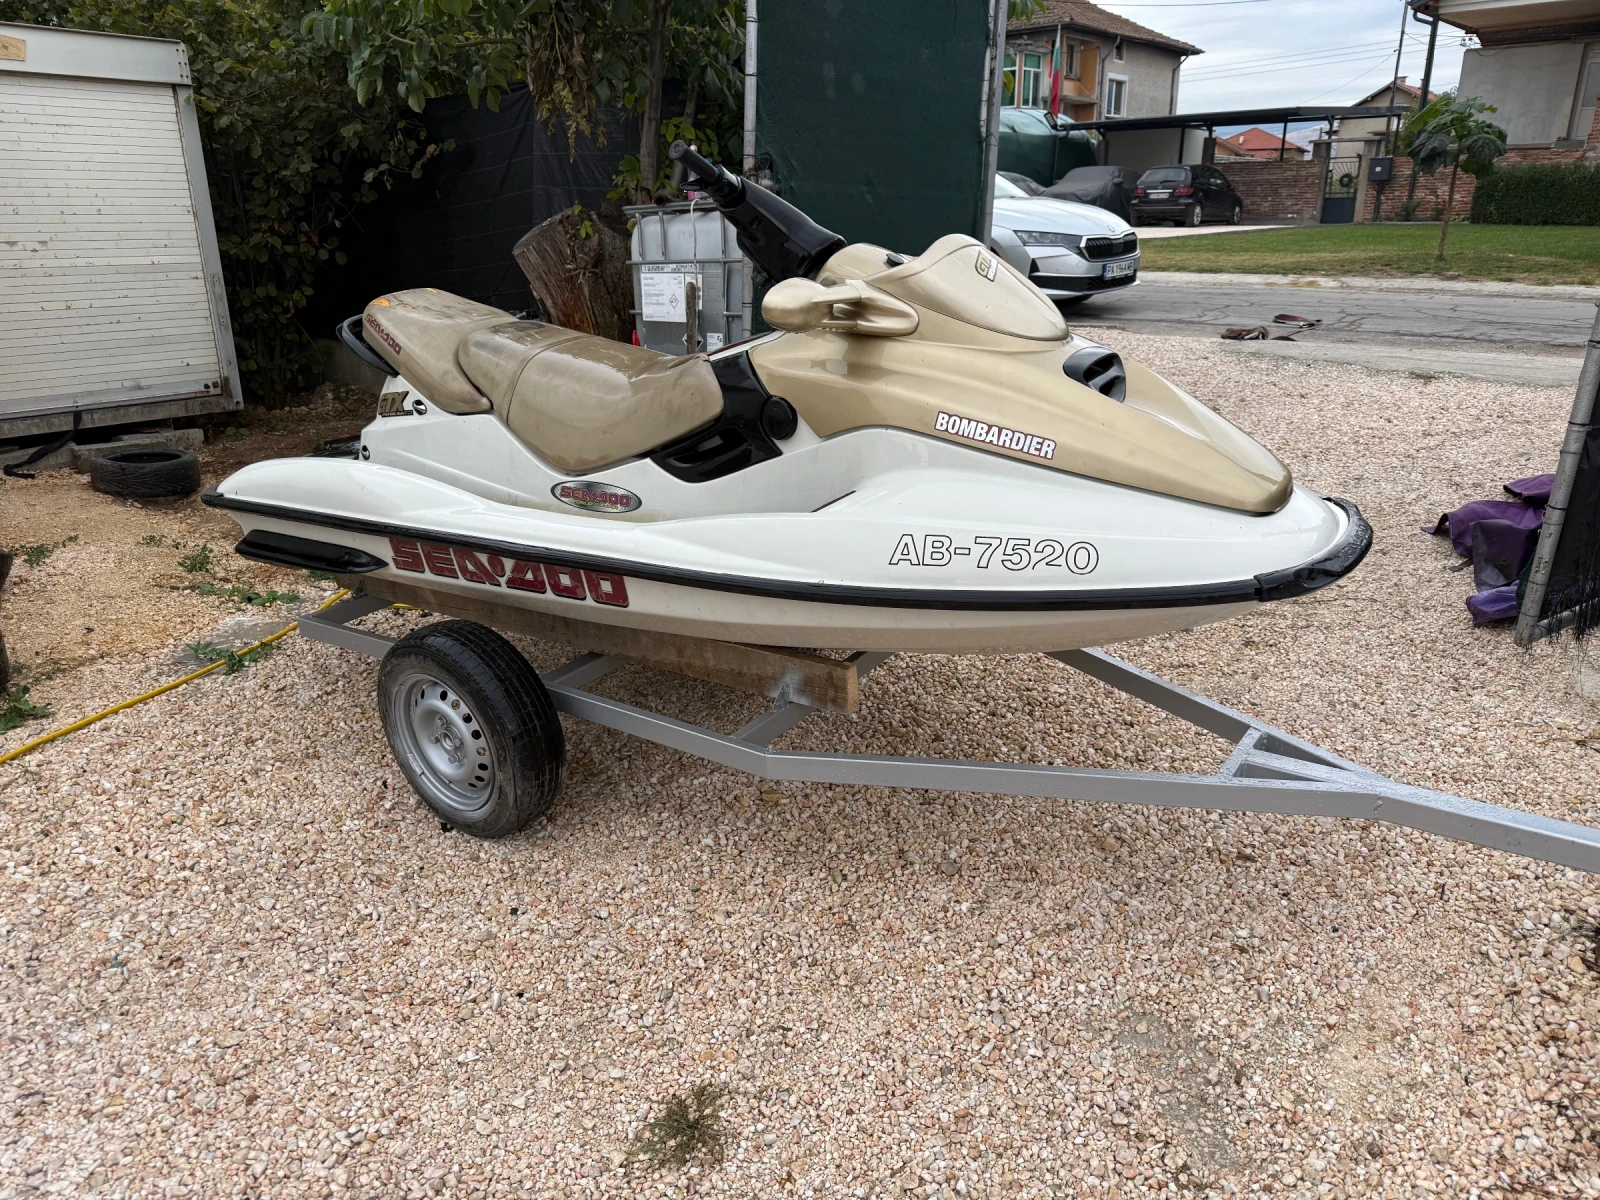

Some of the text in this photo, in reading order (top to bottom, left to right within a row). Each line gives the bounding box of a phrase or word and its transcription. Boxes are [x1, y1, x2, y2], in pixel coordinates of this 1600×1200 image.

[1107, 264, 1115, 275] PA
[378, 391, 409, 415] GTX
[934, 411, 1057, 460] BOMBARDIER
[888, 533, 1100, 575] AB-7520
